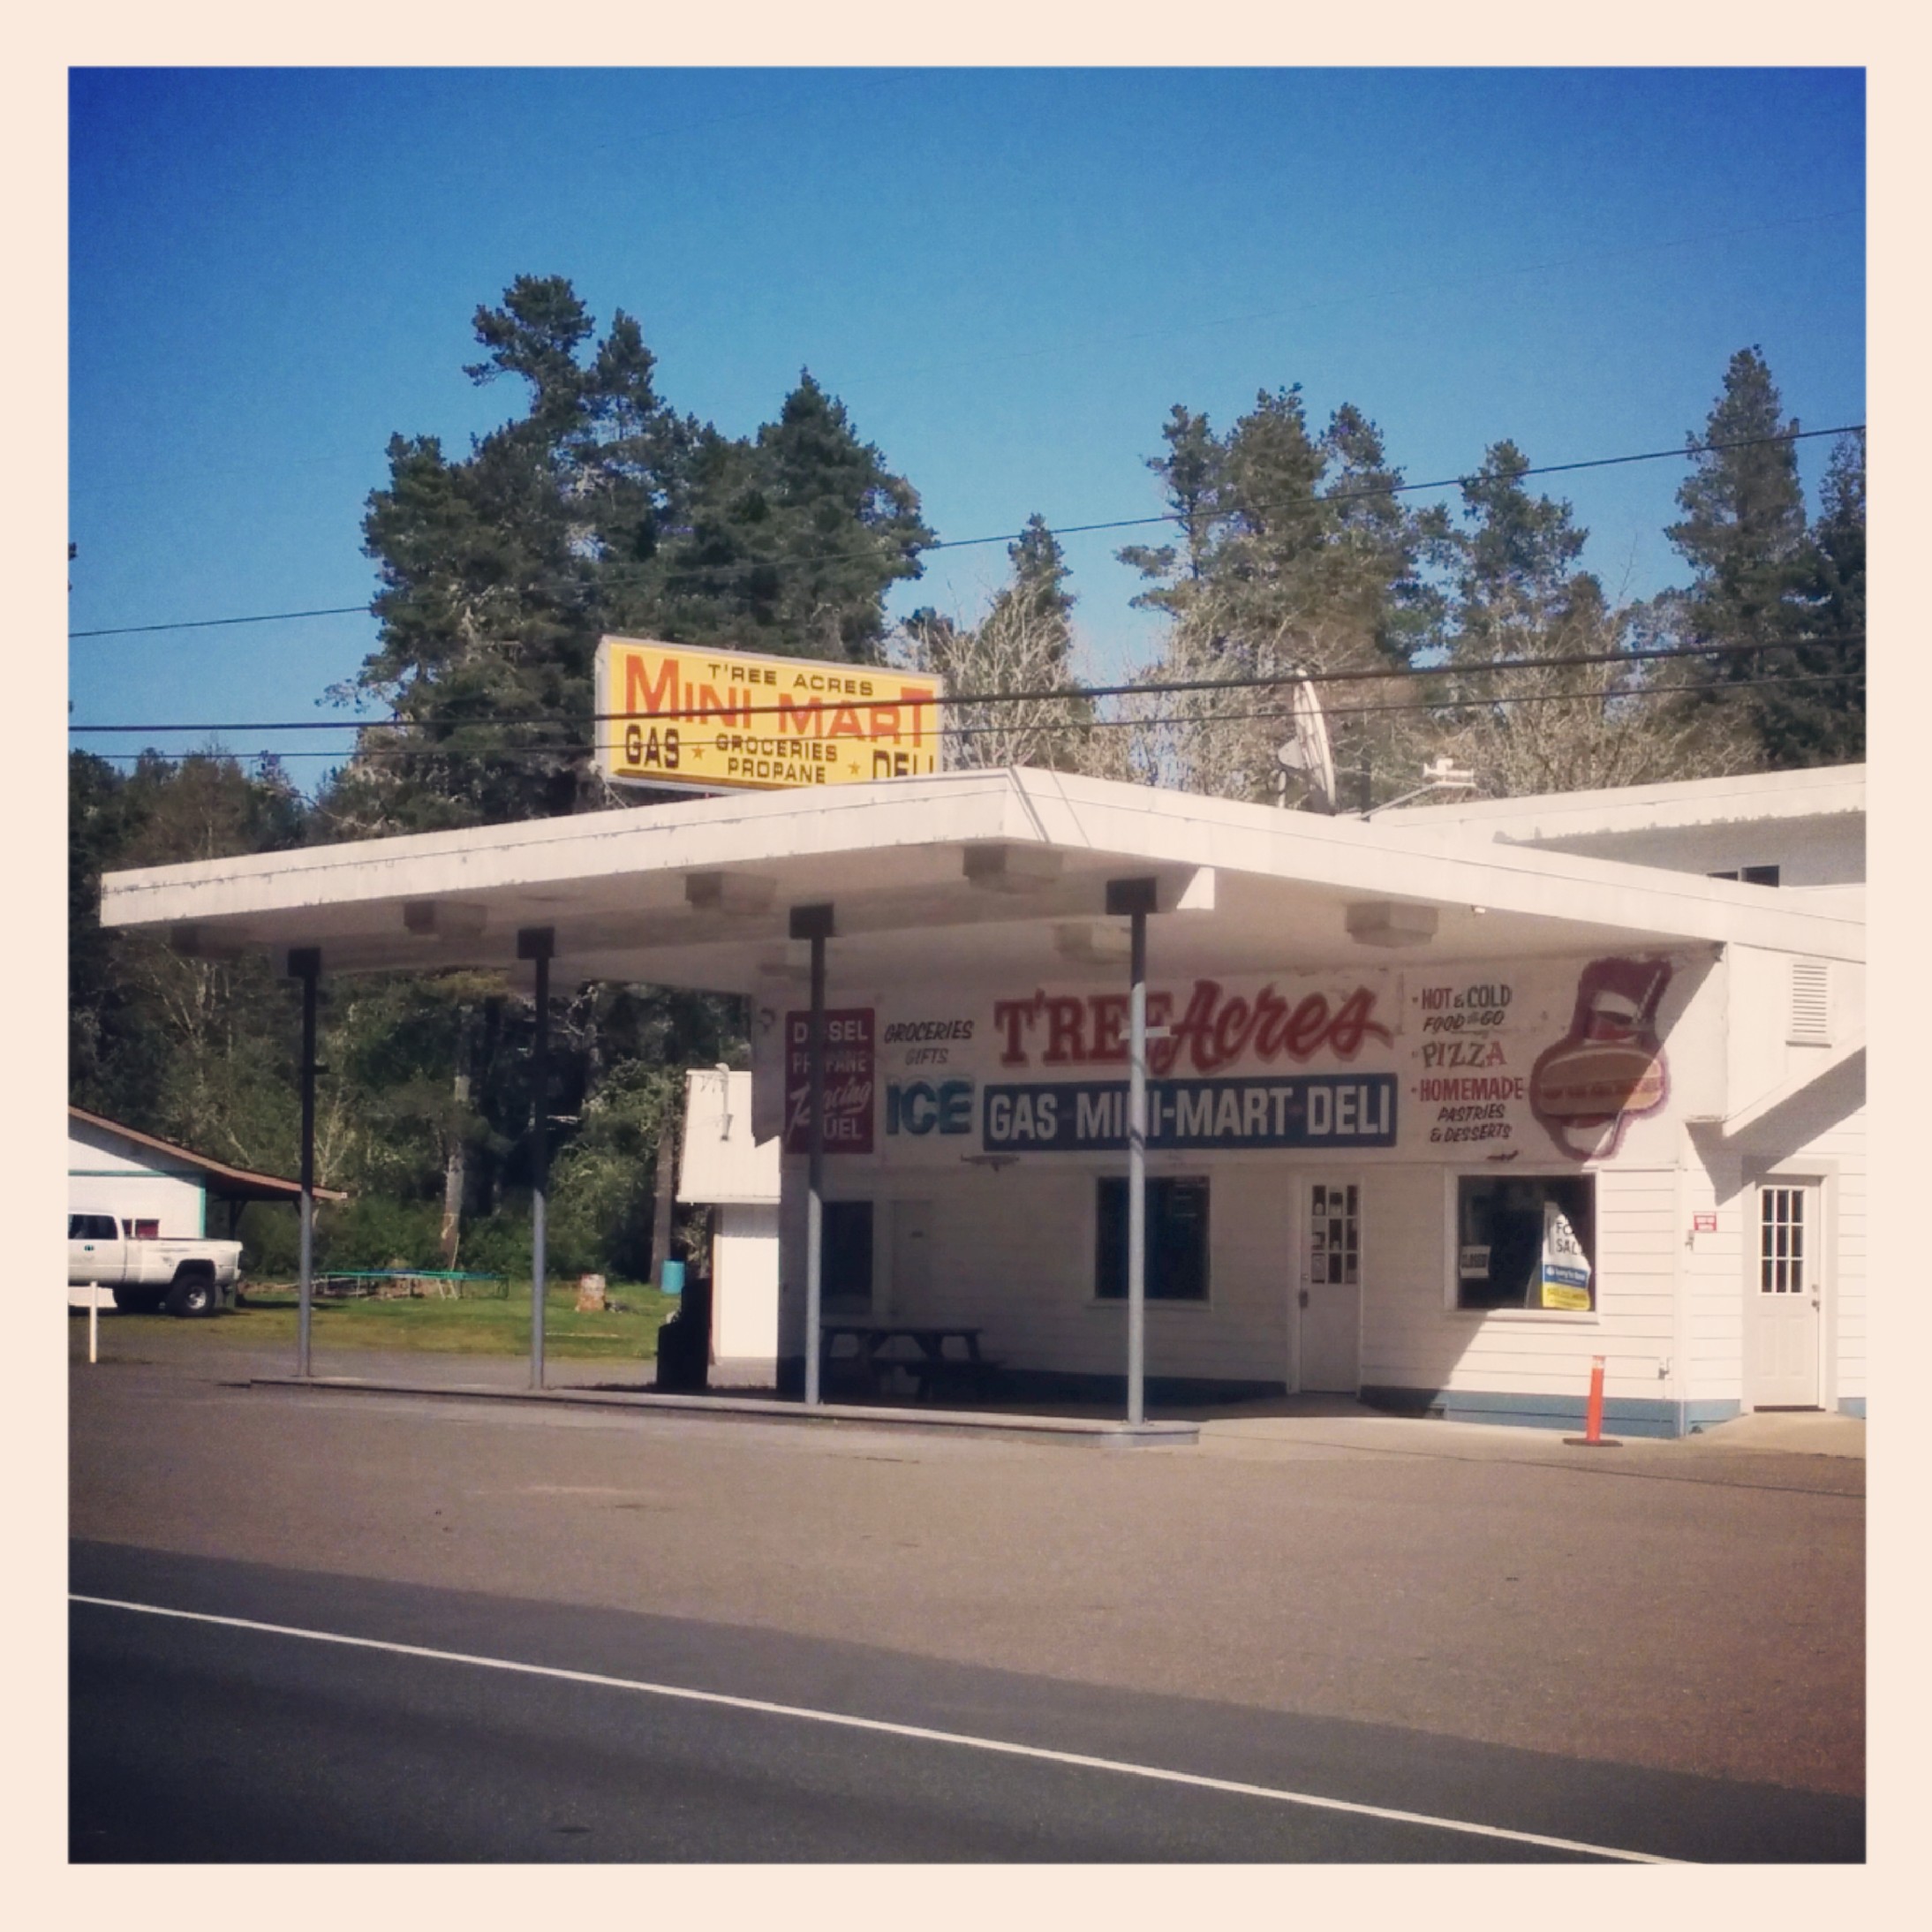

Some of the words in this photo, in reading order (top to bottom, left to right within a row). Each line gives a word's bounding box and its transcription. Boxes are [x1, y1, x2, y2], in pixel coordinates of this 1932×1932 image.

[708, 663, 777, 685] T'REE
[793, 673, 873, 696] ACRES
[626, 653, 751, 729] MINI
[778, 687, 934, 748] MART
[625, 723, 680, 769] GAS
[715, 733, 838, 763] GROCERIES
[728, 758, 826, 784] PROPANE
[1421, 986, 1453, 1010] HOT
[1453, 993, 1465, 1008] &
[1467, 984, 1513, 1008] COLD
[794, 1019, 868, 1044] DSEL
[884, 1020, 975, 1044] GROCERIES
[1149, 978, 1393, 1076] Acres
[1423, 1013, 1465, 1035] FOOD
[1480, 1009, 1505, 1026] GO
[905, 1047, 949, 1066] GIFTS
[1421, 1040, 1508, 1068] PIZZA
[1420, 1077, 1524, 1103] HOMEMADE
[886, 1078, 975, 1136] ICE
[989, 1091, 1059, 1141] GAS
[1307, 1083, 1391, 1136] DELI
[1437, 1103, 1506, 1122] PASTRIES
[823, 1117, 863, 1141] UEL
[1443, 1122, 1513, 1143] DESSERTS
[1555, 1221, 1575, 1235] FO
[1555, 1237, 1579, 1256] SAL
